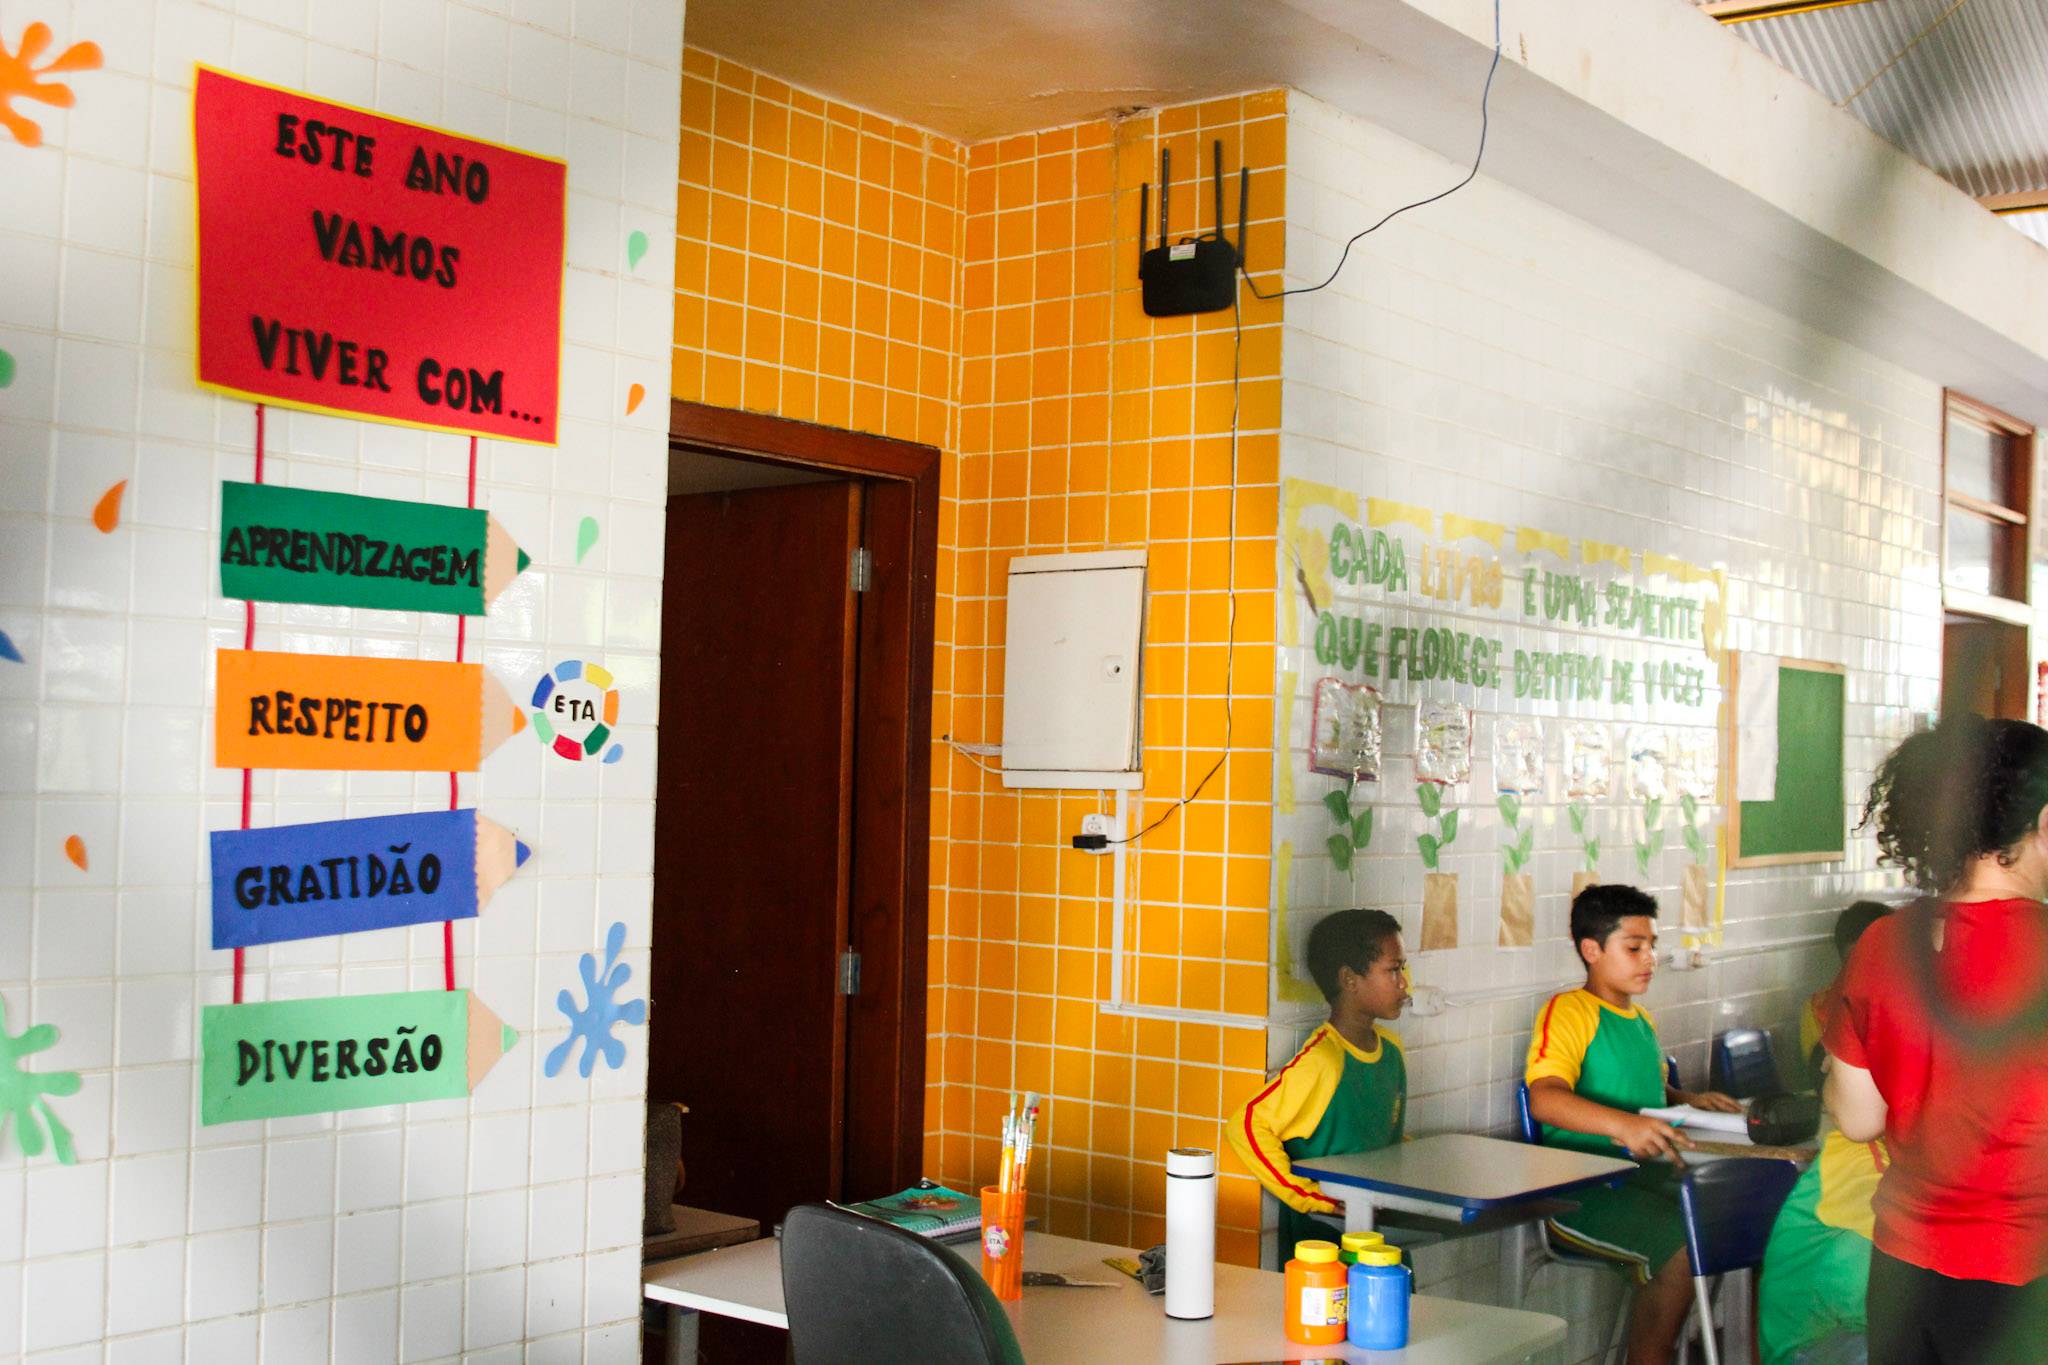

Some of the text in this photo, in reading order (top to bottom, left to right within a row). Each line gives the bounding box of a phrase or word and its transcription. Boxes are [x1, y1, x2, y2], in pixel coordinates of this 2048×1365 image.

[274, 113, 490, 204] ESTE ANO
[311, 209, 460, 289] VAMOS
[251, 315, 542, 424] VIVER COM...
[222, 525, 482, 587] APRENDIZAGEM
[1330, 522, 1408, 592] CADA
[1543, 571, 1598, 627] UMA
[1604, 580, 1699, 641] SEMENTE
[1314, 611, 1384, 678] QUE
[1389, 626, 1503, 689] FLORECE
[1514, 648, 1605, 702] DENTRO
[1611, 658, 1644, 705] DE
[248, 691, 428, 744] RESPEITO
[554, 695, 596, 722] ETA
[235, 842, 442, 909] GRATIDÃO
[237, 1026, 443, 1086] DIVERSÃO
